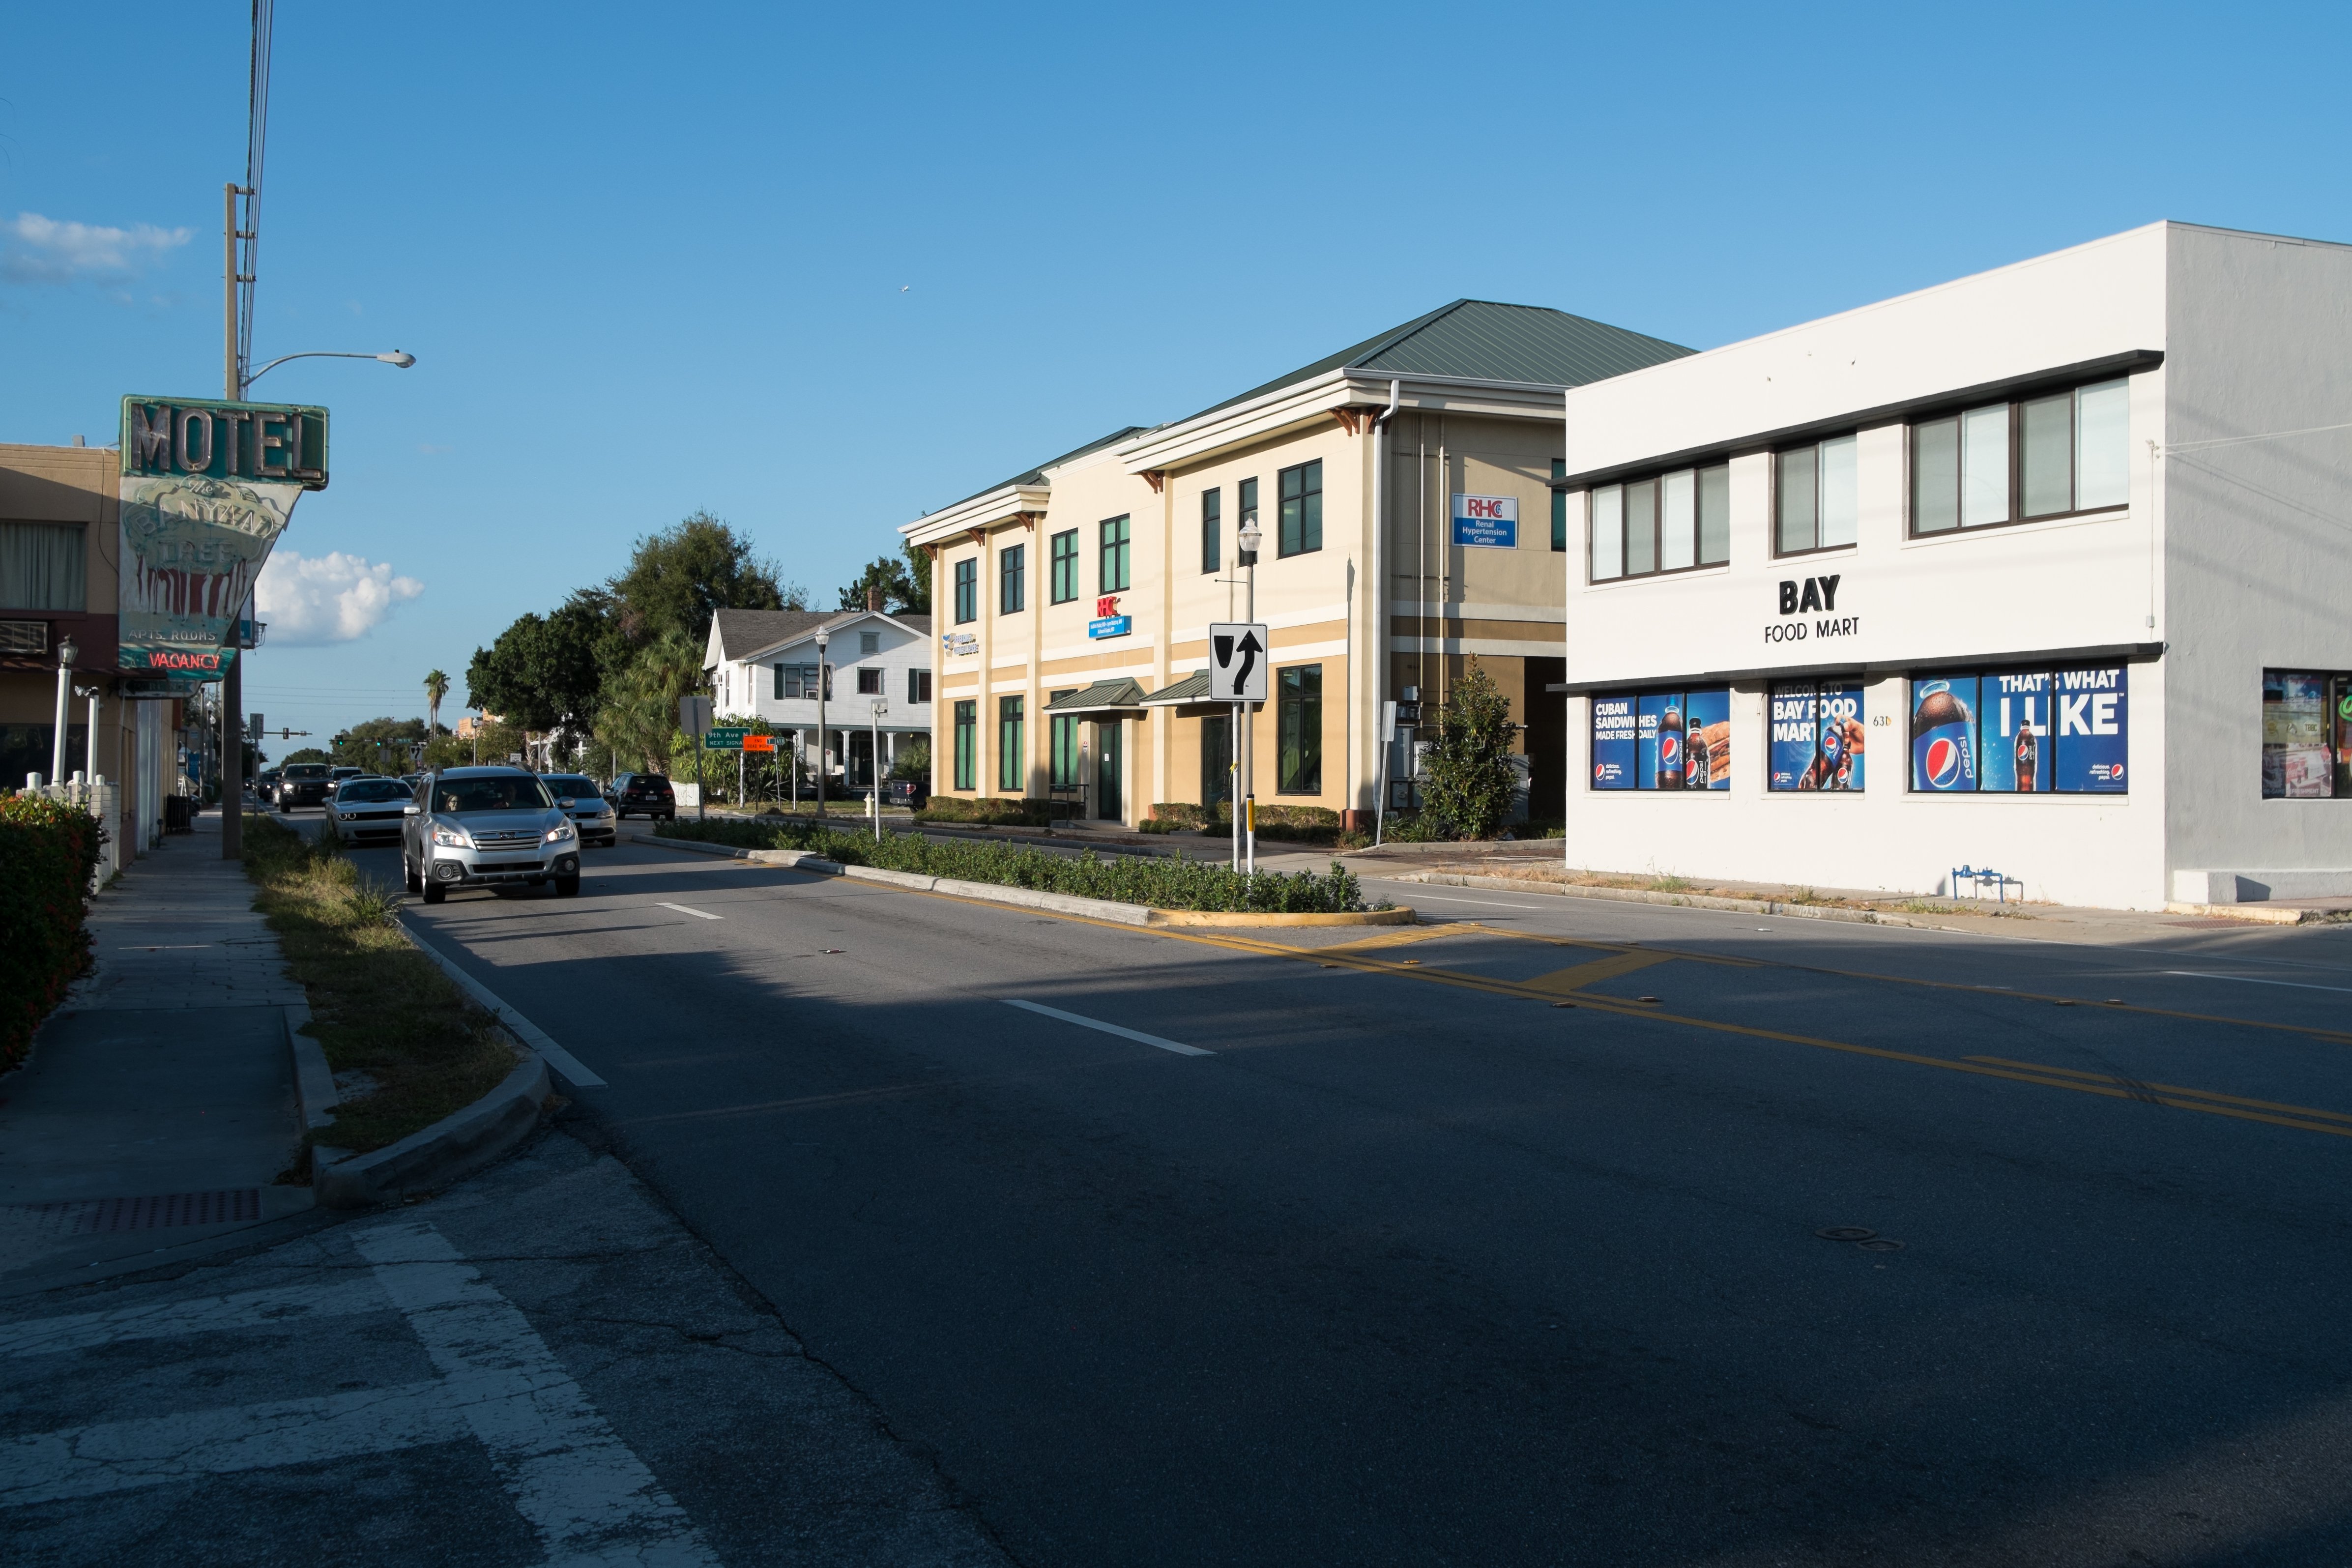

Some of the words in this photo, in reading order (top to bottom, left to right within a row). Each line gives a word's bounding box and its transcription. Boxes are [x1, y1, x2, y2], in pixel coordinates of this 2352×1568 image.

[131, 403, 321, 479] MOTEL
[189, 480, 214, 494] The
[136, 499, 268, 535] BANYAN
[1468, 499, 1503, 518] RHC
[1463, 526, 1507, 536] Hypertension
[158, 541, 234, 563] TREE
[1779, 574, 1840, 616] BAY
[1097, 596, 1117, 617] RHC
[172, 630, 215, 640] ROOMS
[1765, 623, 1807, 643] FOOD
[1817, 617, 1859, 638] MART
[149, 652, 220, 668] VACANCY
[1829, 683, 1843, 696] TO
[2063, 669, 2120, 690] WHAT
[1596, 702, 1627, 716] CUBAN
[1774, 700, 1805, 721] BAY
[1808, 698, 1857, 719] FOOD
[2001, 697, 2010, 737] I
[2025, 693, 2118, 736] LKE
[1596, 730, 1615, 740] MADE
[1639, 729, 1657, 739] DAILY
[1958, 736, 1974, 779] pepsi
